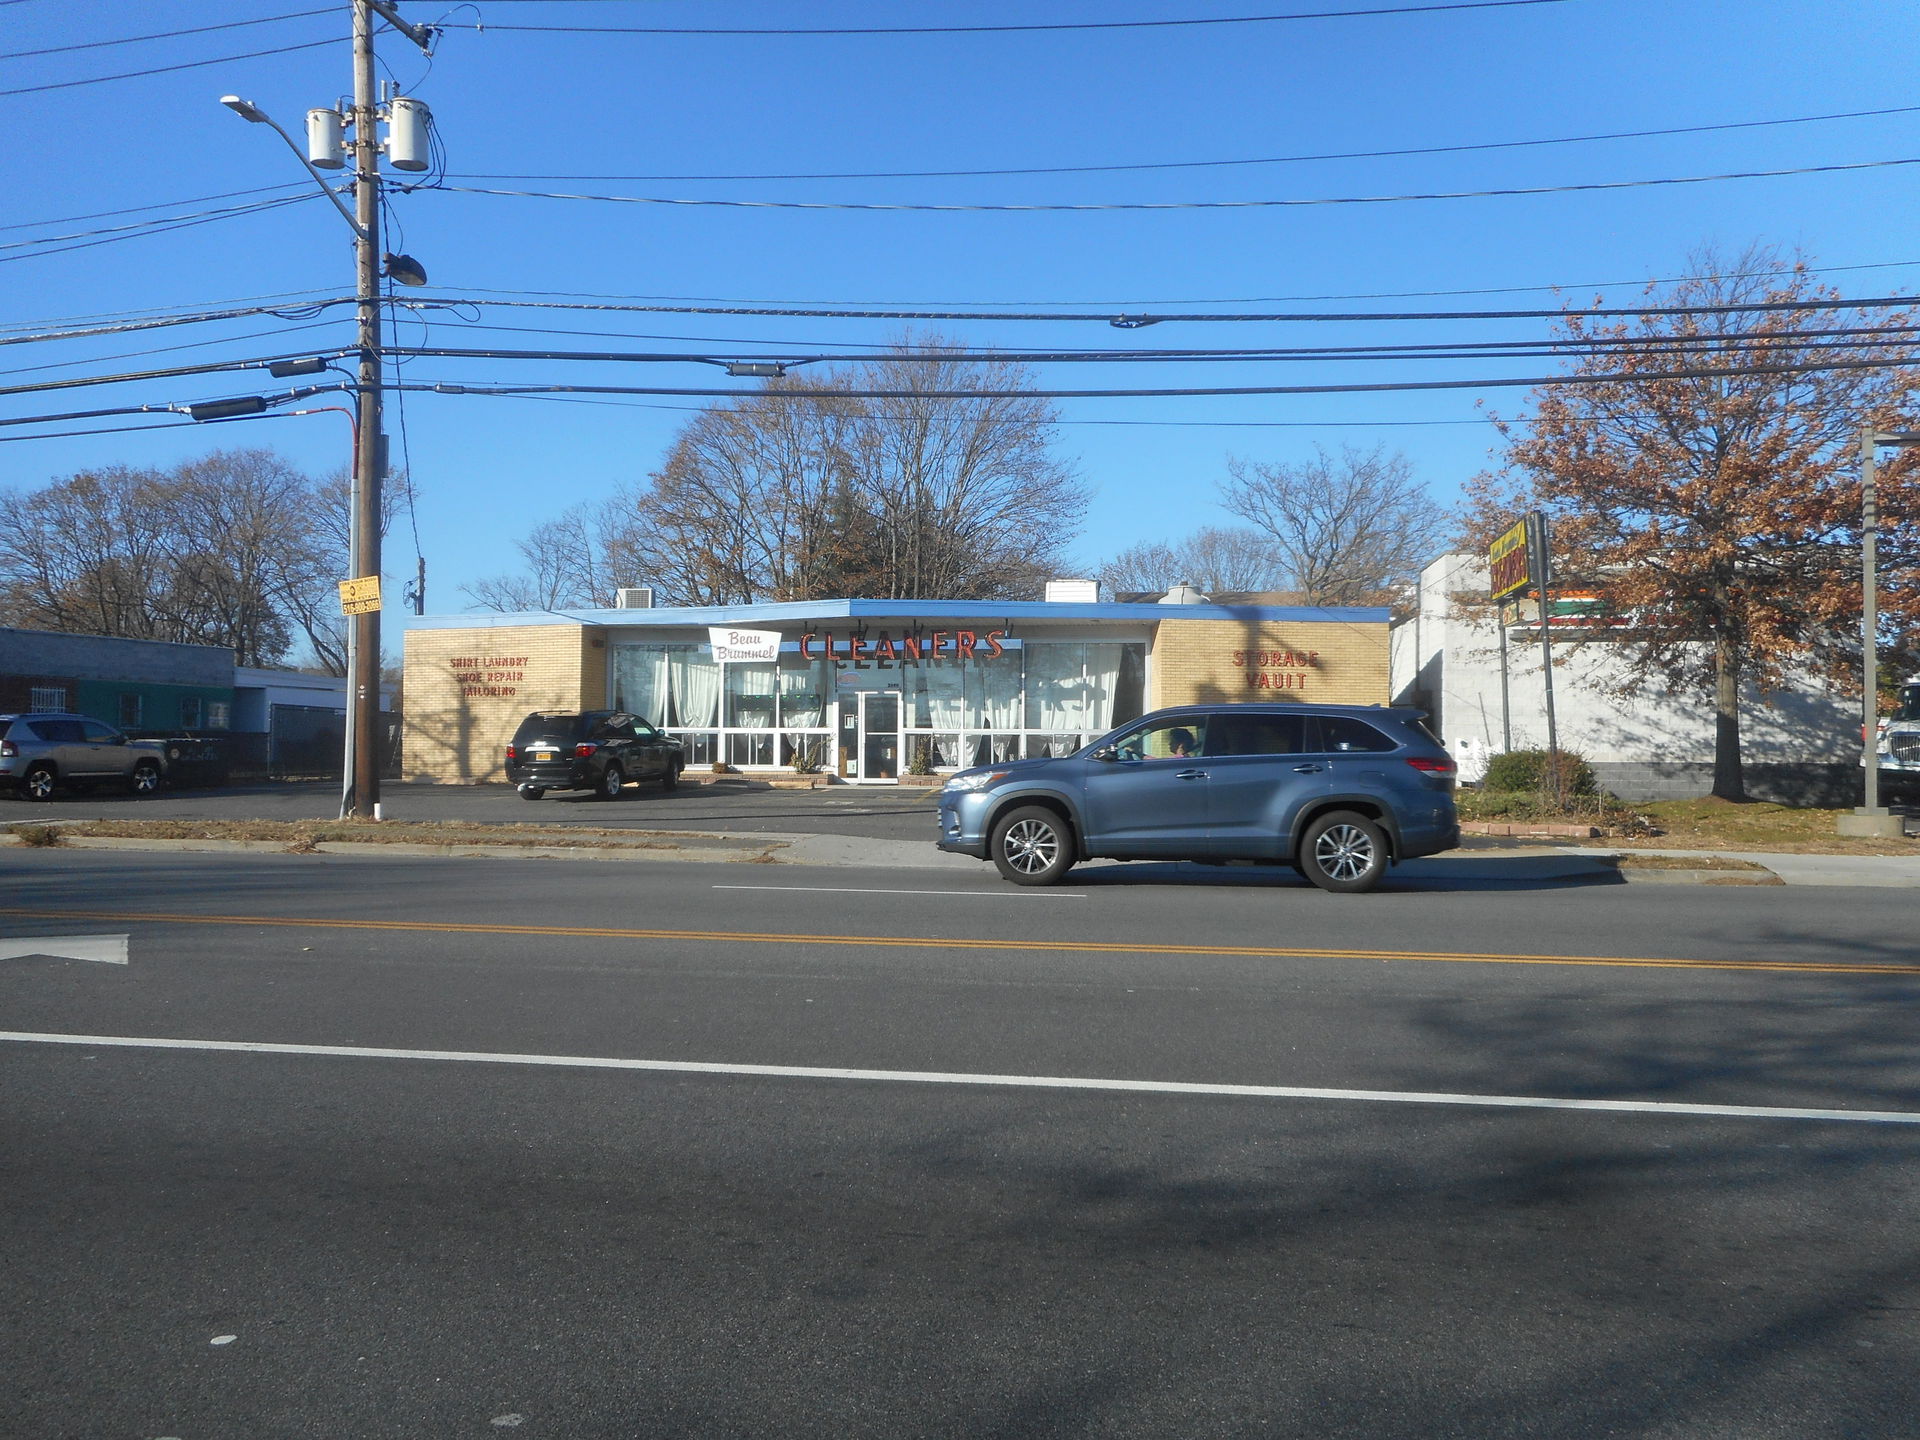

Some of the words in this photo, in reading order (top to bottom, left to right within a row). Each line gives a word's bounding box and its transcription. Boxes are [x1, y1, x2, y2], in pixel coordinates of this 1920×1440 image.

[728, 631, 762, 645] Beau
[716, 645, 775, 660] Brummel
[800, 630, 1004, 661] CLEANERS
[450, 658, 479, 668] SHIRT
[484, 657, 529, 667] LAUNDRY
[1232, 650, 1320, 667] STORAGE
[456, 672, 482, 682] SHOE
[487, 672, 523, 682] REPAIR
